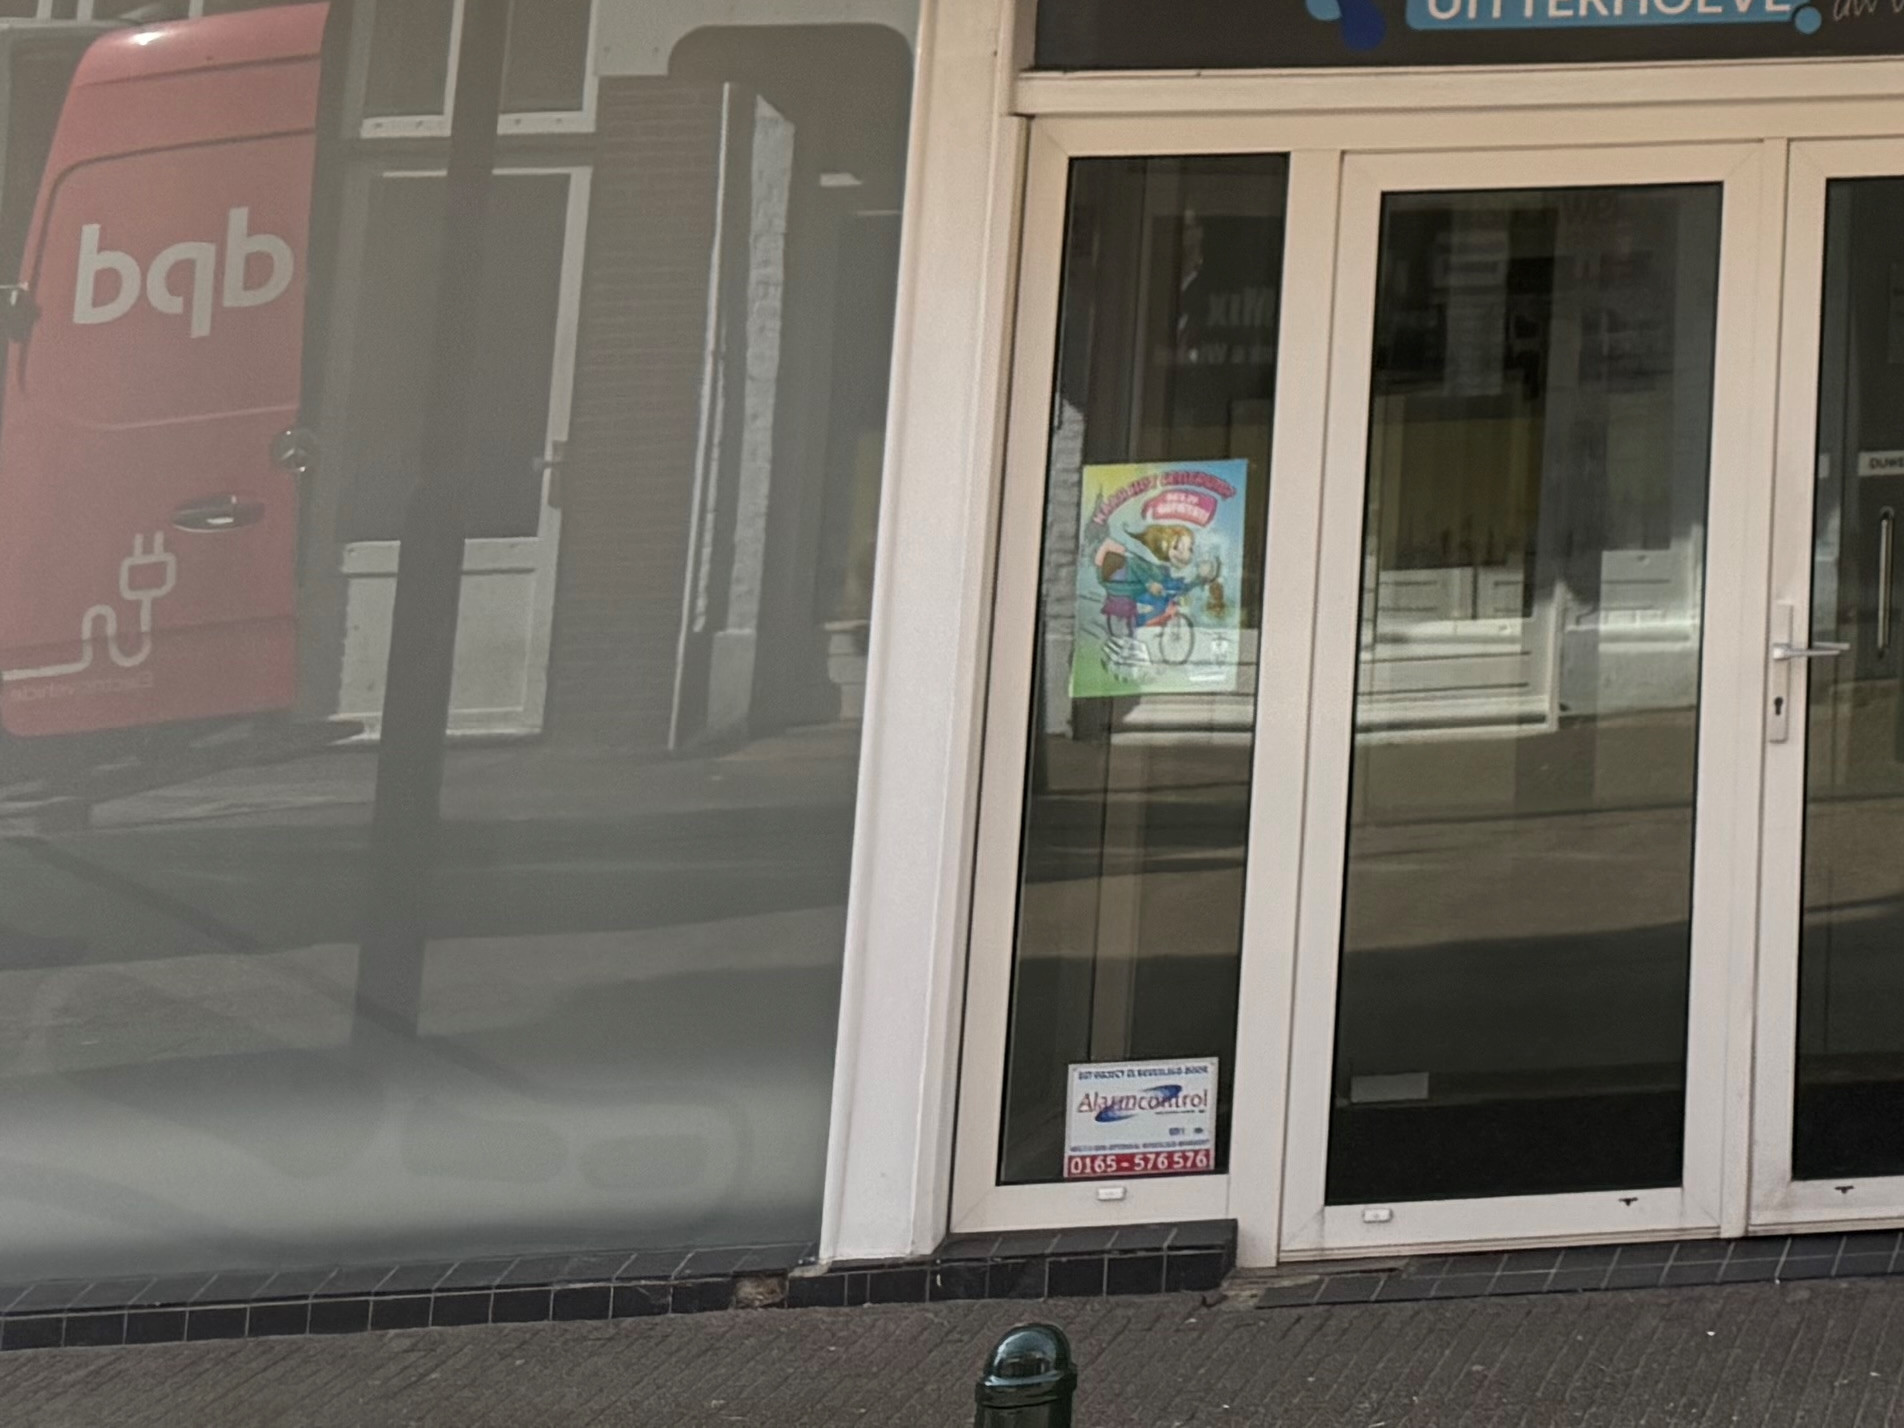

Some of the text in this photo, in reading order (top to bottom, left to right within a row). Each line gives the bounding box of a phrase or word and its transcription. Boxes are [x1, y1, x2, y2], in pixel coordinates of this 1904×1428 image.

[1077, 1089, 1208, 1113] Alarmcontrol
[1071, 1156, 1117, 1173] 0165
[1134, 1153, 1169, 1170] 576
[1173, 1151, 1207, 1168] 576
